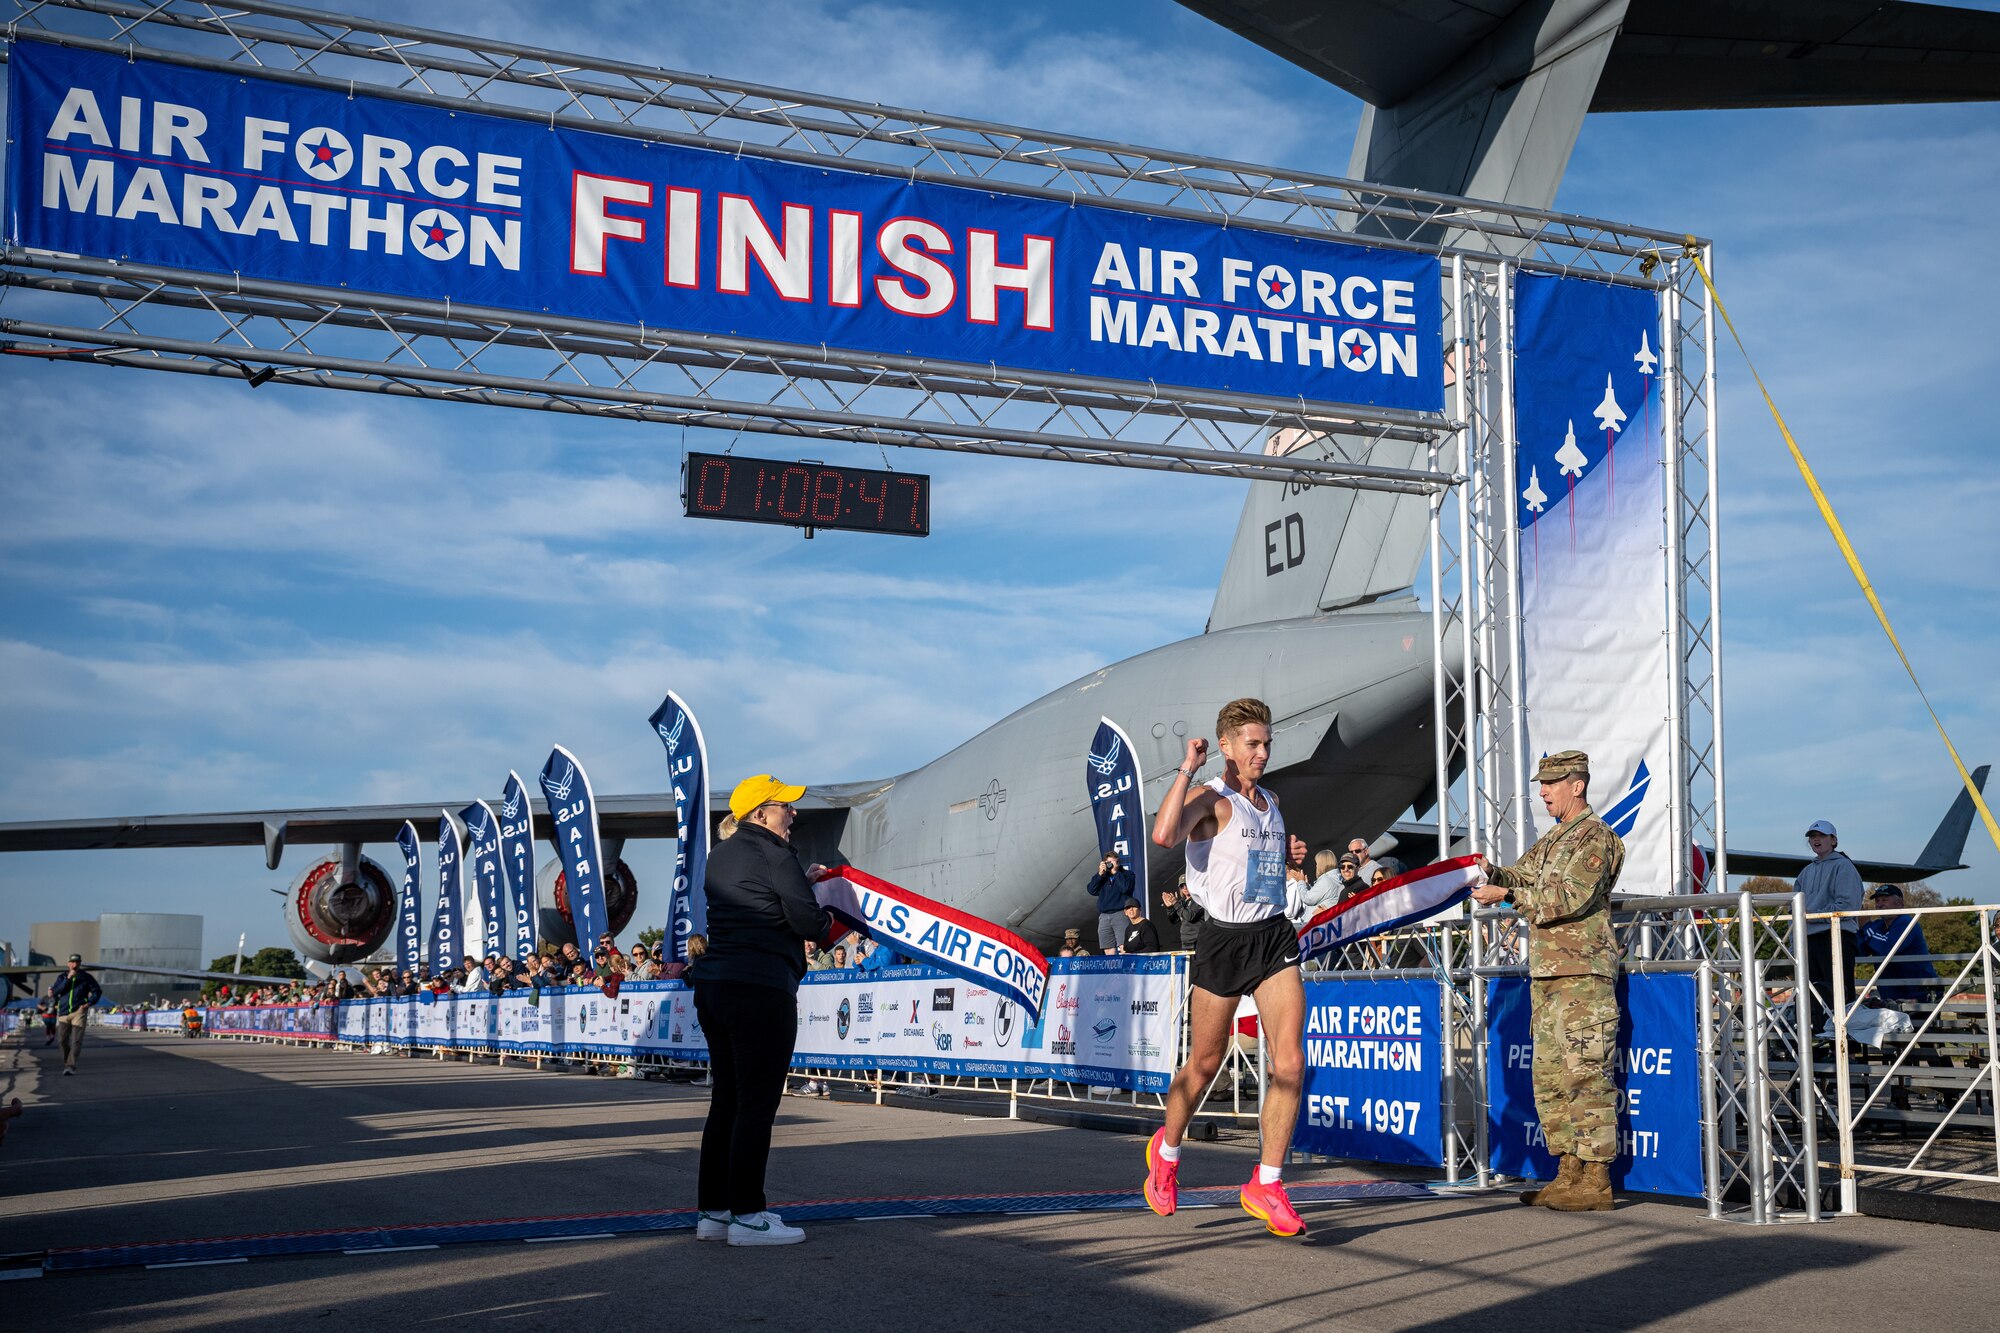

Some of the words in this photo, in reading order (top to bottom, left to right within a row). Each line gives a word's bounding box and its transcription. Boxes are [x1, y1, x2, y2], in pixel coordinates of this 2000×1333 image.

[46, 87, 211, 163] AIR
[243, 116, 522, 208] FORCE
[42, 152, 522, 271] MARATHON
[569, 169, 1054, 332] FINISH
[1091, 241, 1200, 299] AIR
[1222, 257, 1416, 324] FORCE
[1090, 295, 1418, 378] MARATHON
[1265, 512, 1305, 577] ED
[1242, 828, 1257, 838] U.S.
[1257, 861, 1283, 877] 4292
[860, 892, 912, 939] U.S.
[918, 921, 971, 962] AIR
[974, 940, 1043, 1004] FORCE
[903, 1028, 925, 1037] EXCHANGE
[937, 1034, 952, 1051] KBR
[1307, 1006, 1342, 1034] AIR
[1348, 1005, 1422, 1035] FORCE
[1307, 1039, 1422, 1072] MARATHON
[1307, 1094, 1353, 1130] EST.
[1361, 1098, 1421, 1136] 1997
